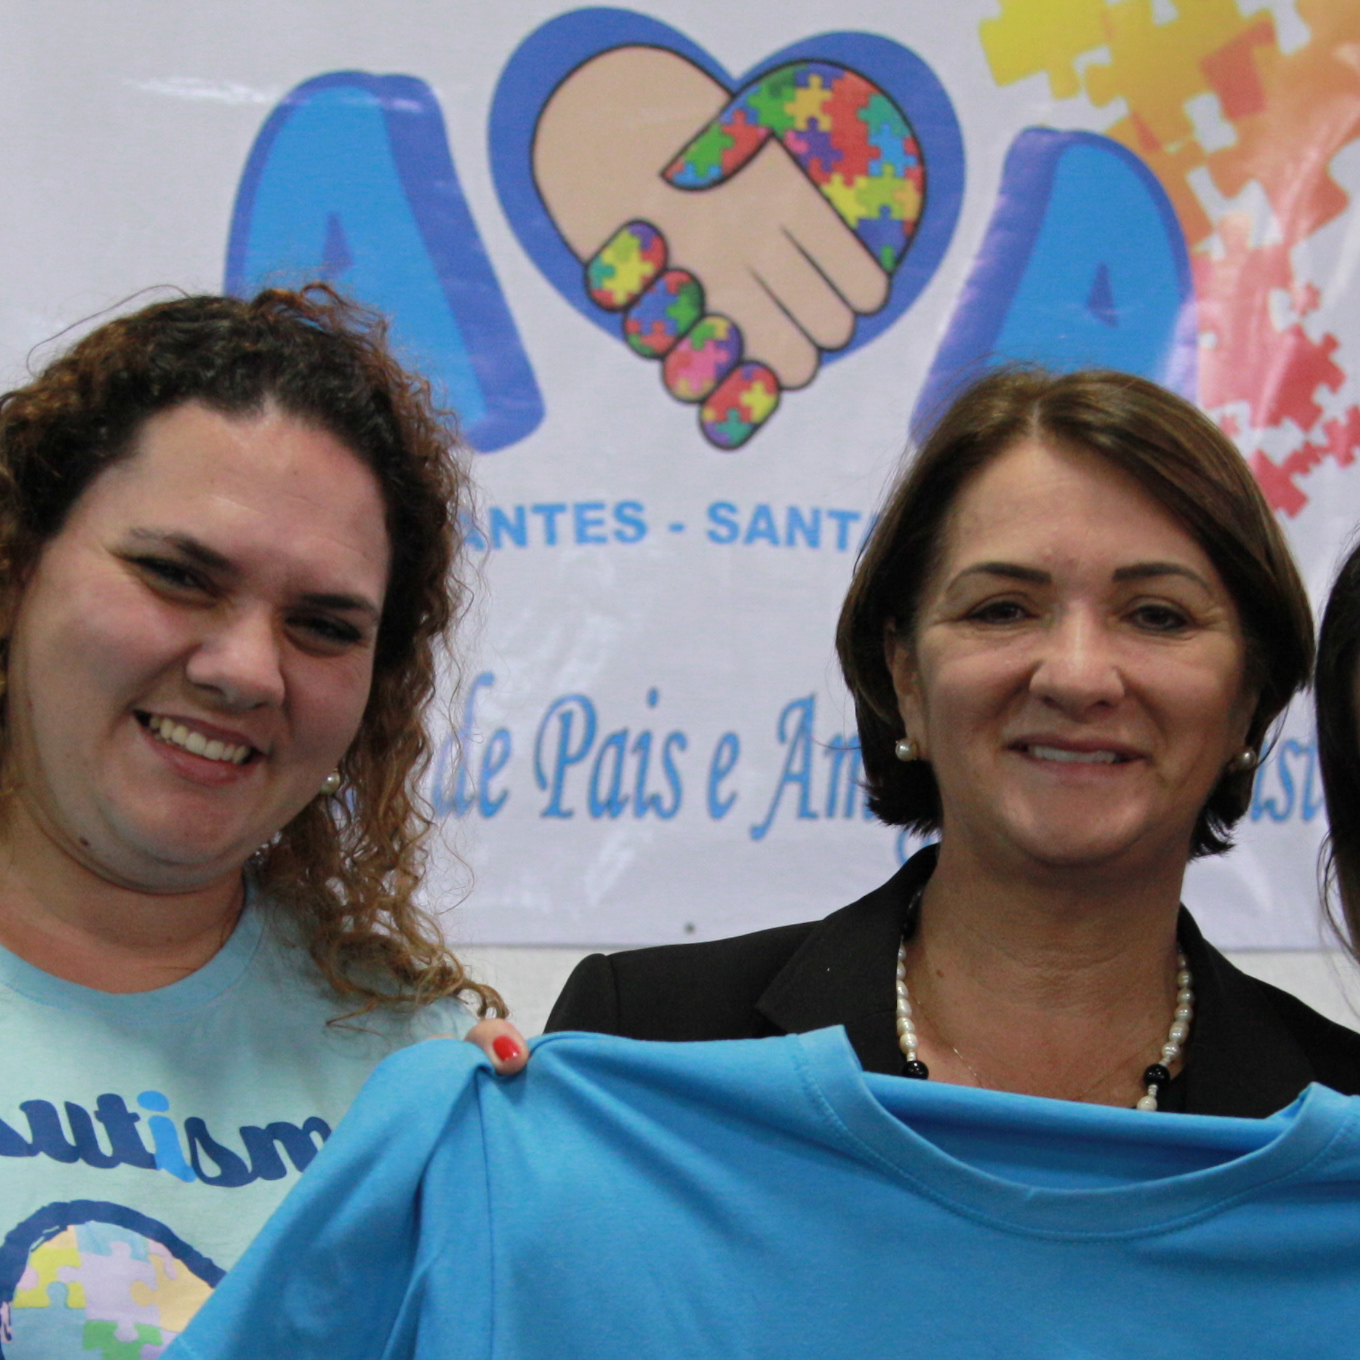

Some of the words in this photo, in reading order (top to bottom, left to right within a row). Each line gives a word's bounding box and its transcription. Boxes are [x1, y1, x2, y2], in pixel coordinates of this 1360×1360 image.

[707, 501, 876, 552] SANT
[535, 688, 687, 819] Pais
[707, 732, 740, 819] e
